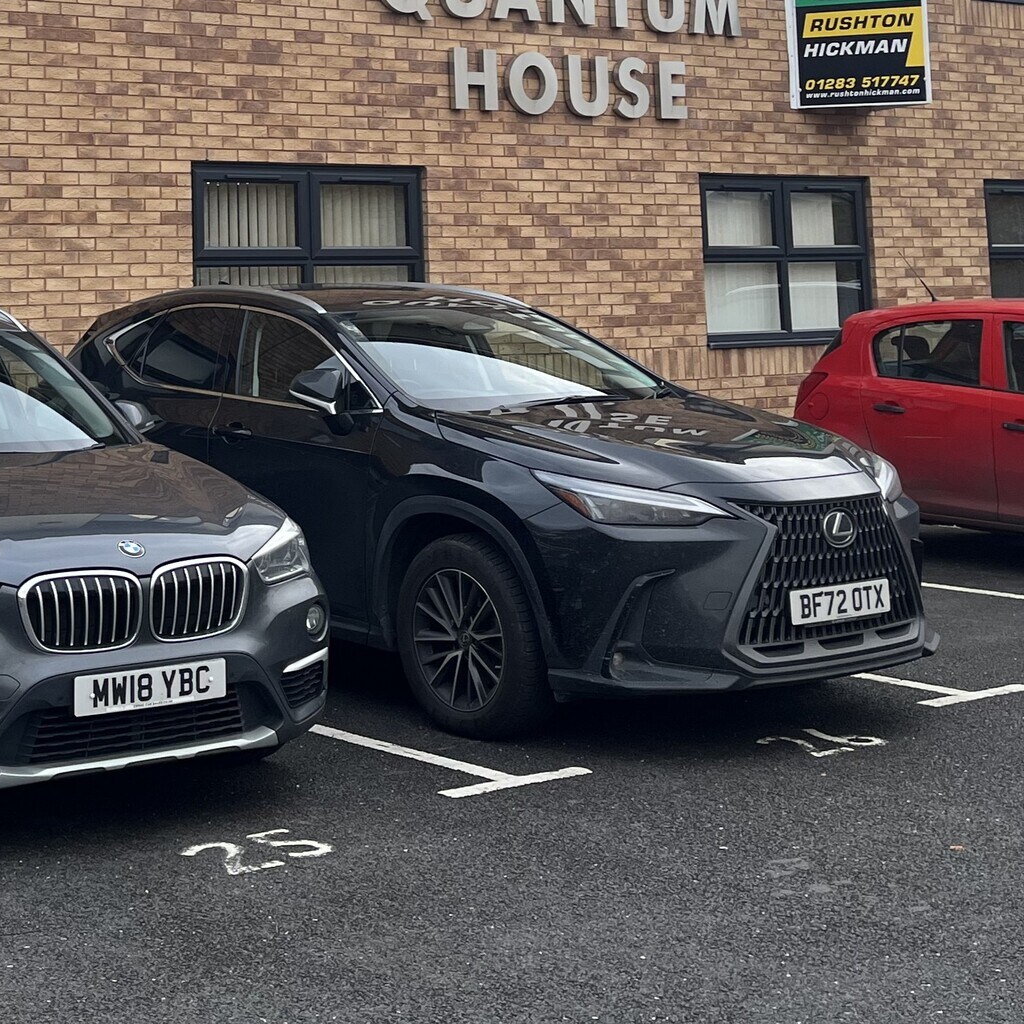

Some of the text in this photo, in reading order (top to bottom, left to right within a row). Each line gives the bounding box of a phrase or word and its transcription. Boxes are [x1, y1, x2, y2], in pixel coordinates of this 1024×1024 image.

[809, 12, 914, 33] RUSHTON
[803, 38, 908, 58] HICKMAN
[448, 46, 688, 121] HOUSE
[805, 74, 920, 91] 01283 517747
[805, 87, 920, 99] www.rushtonhickman.com
[799, 583, 885, 619] BF72 OTX
[92, 665, 210, 708] MW18 YBC
[755, 728, 888, 758] 26
[178, 828, 334, 876] 25
